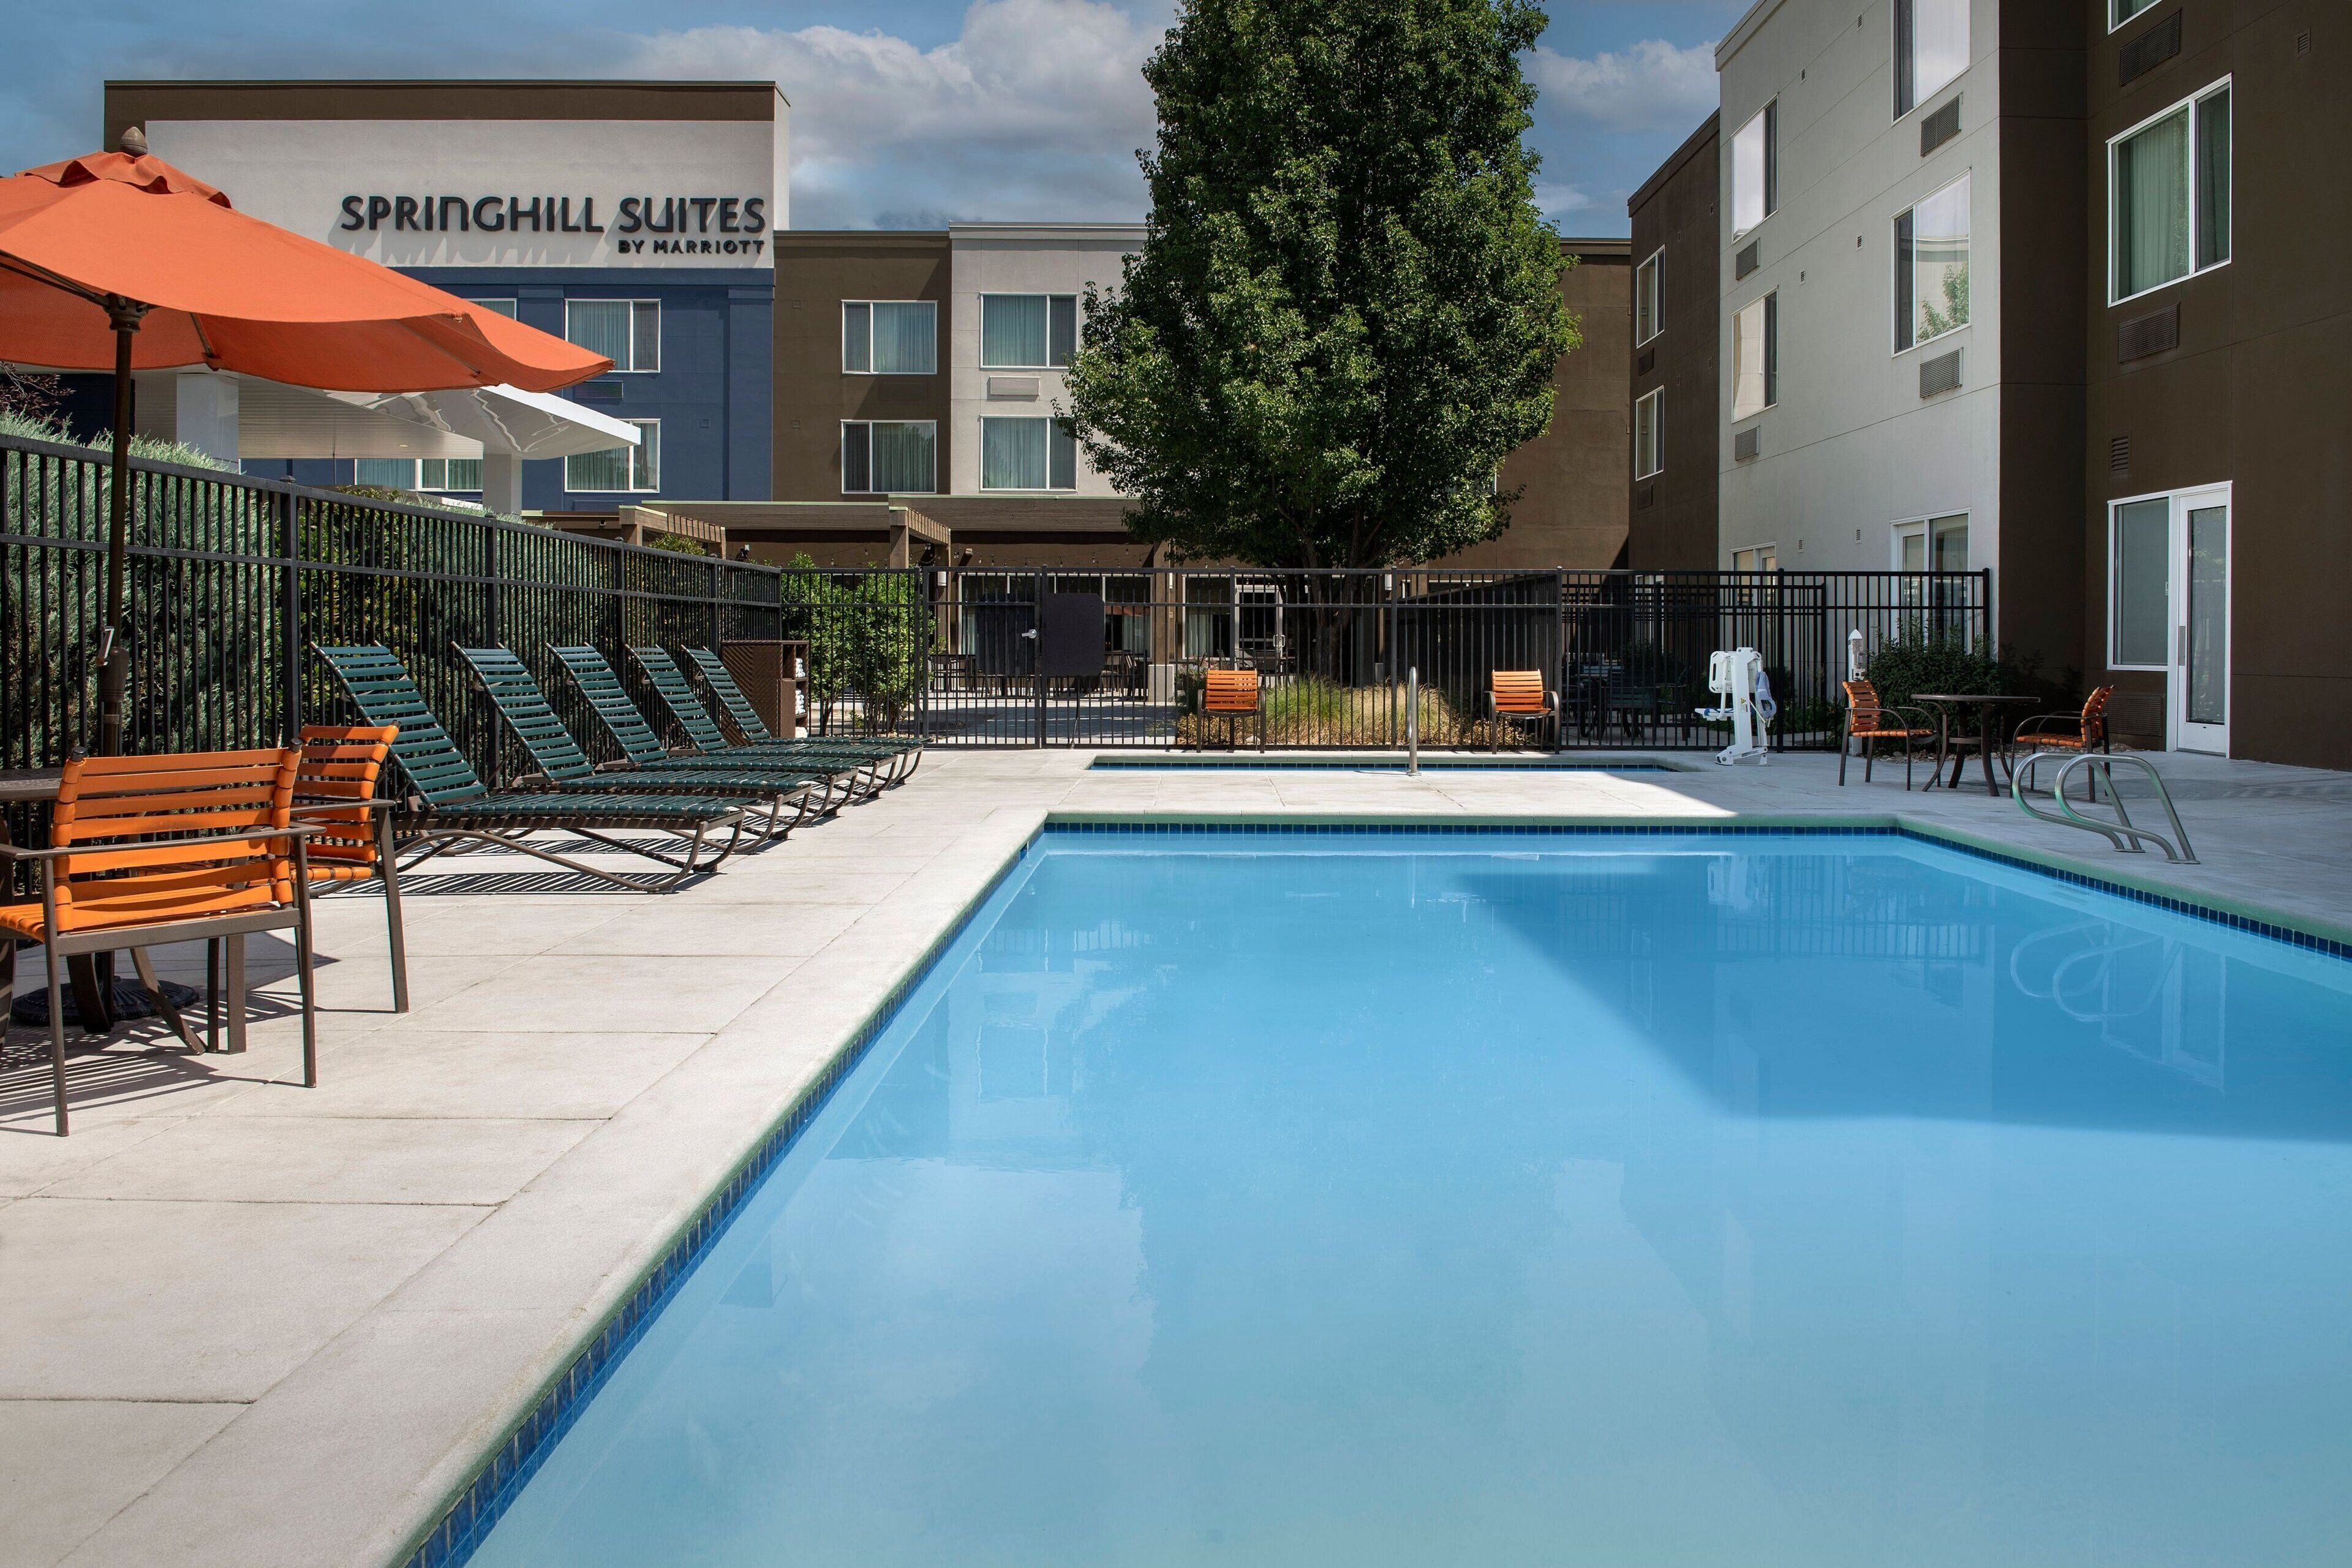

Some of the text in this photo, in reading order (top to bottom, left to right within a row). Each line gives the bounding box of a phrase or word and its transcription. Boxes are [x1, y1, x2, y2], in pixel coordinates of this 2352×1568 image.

[341, 195, 766, 233] SPRINGHILL SUITES
[618, 239, 765, 255] BY MARRIOTT
